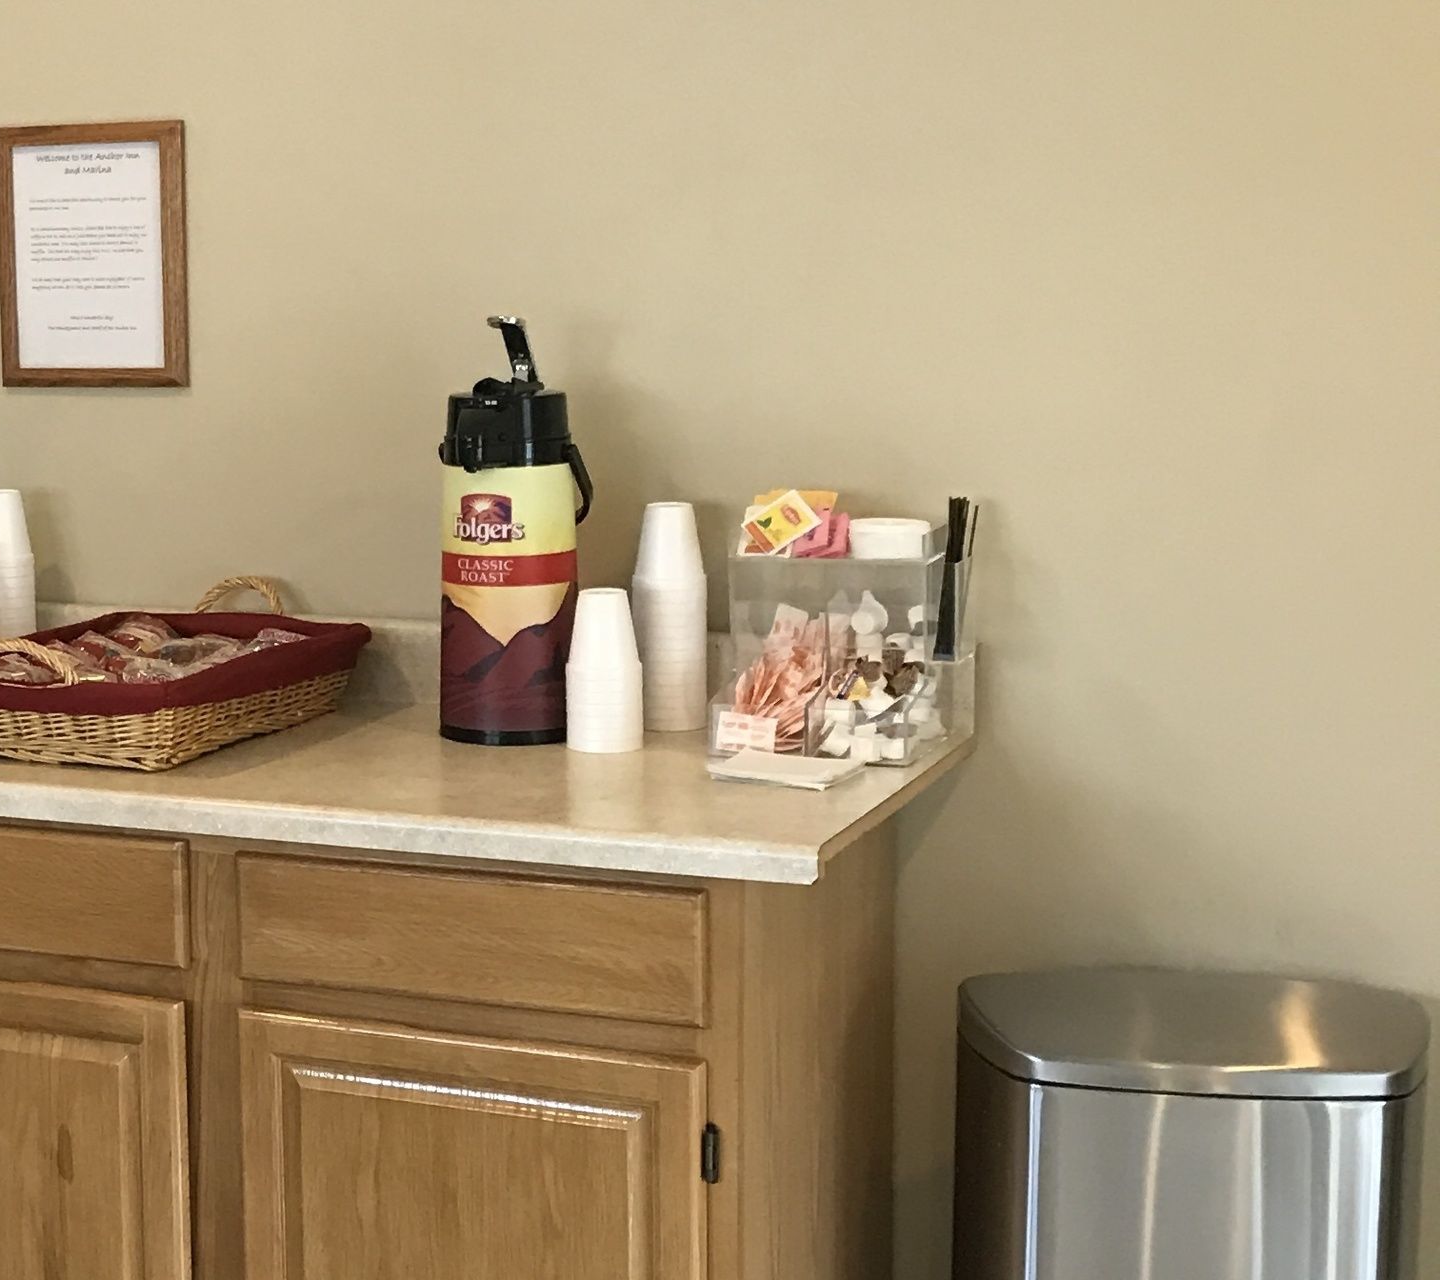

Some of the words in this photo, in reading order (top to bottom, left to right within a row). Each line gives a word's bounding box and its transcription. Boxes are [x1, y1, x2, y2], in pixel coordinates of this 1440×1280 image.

[36, 153, 70, 163] Welcome
[454, 513, 525, 545] Folgers
[458, 558, 514, 572] CLASSIC
[460, 570, 504, 583] ROAST
